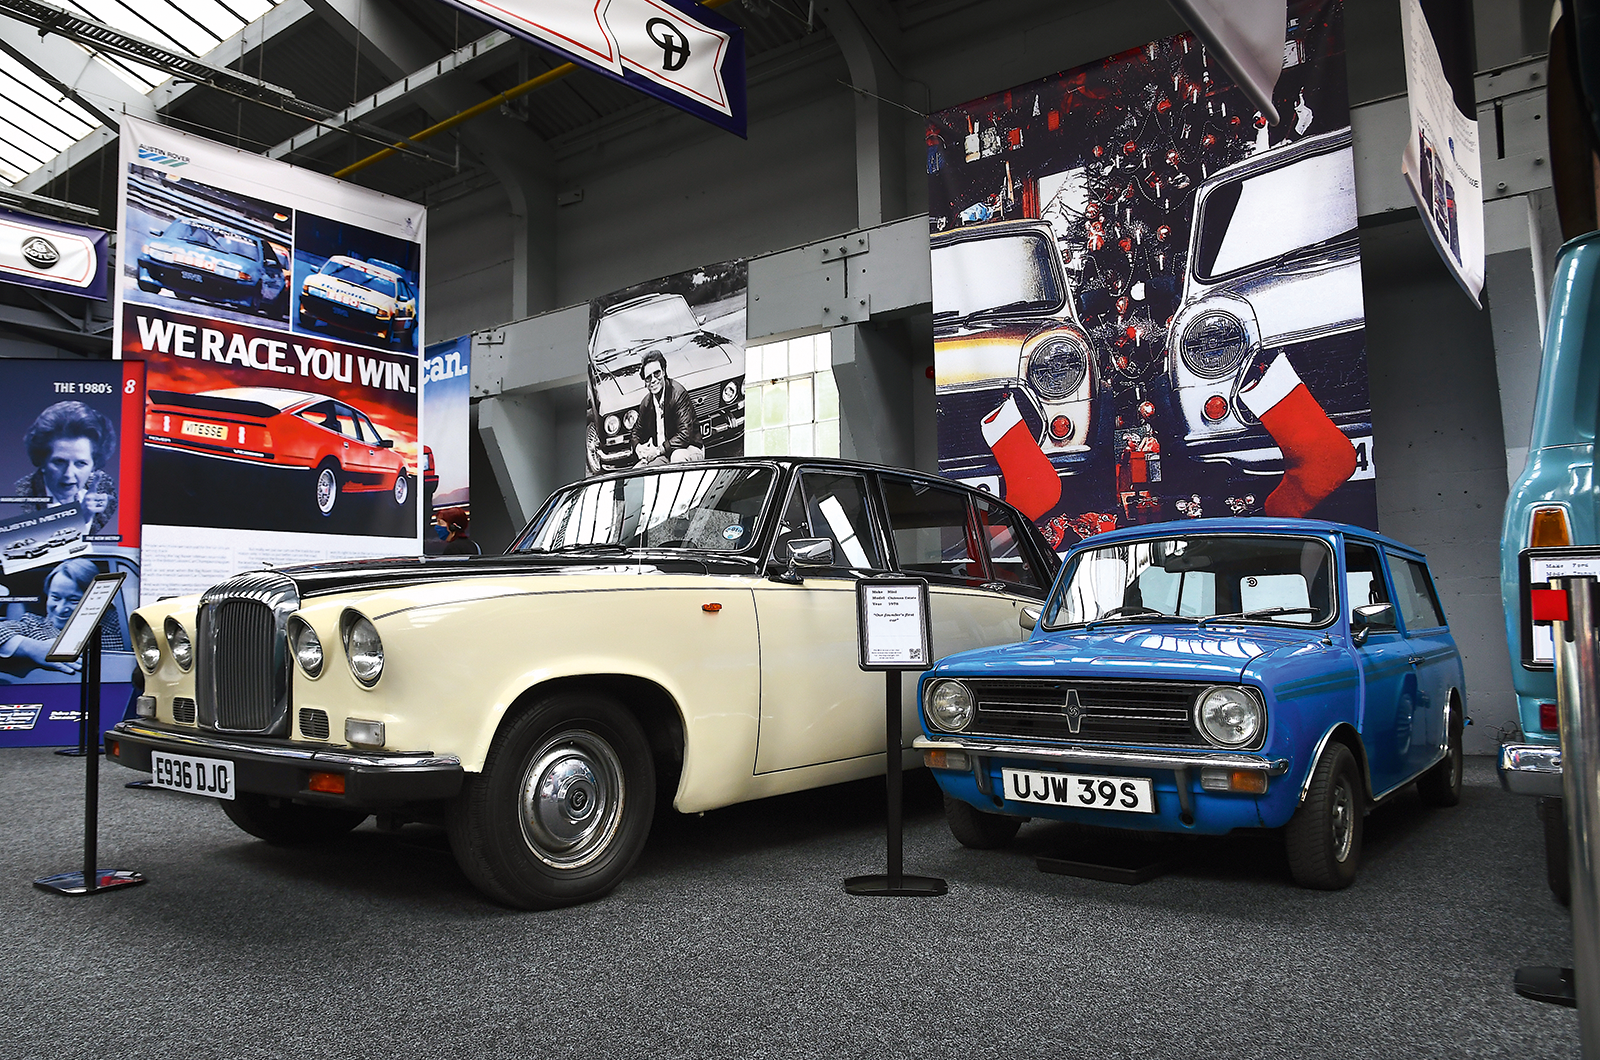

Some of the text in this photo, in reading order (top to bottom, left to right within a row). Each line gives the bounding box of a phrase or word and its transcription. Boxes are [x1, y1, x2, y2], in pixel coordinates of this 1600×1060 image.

[139, 143, 191, 163] AUSTIN ROVER
[25, 246, 58, 260] LOTUS
[136, 316, 196, 358] WE
[357, 356, 417, 394] WIN.
[53, 382, 113, 394] THE 1980's
[124, 379, 136, 394] 8
[186, 422, 224, 438] VITESSE
[39, 508, 78, 523] METRO
[156, 757, 228, 794] E936 DJO
[1013, 773, 1139, 809] UJW 39S
